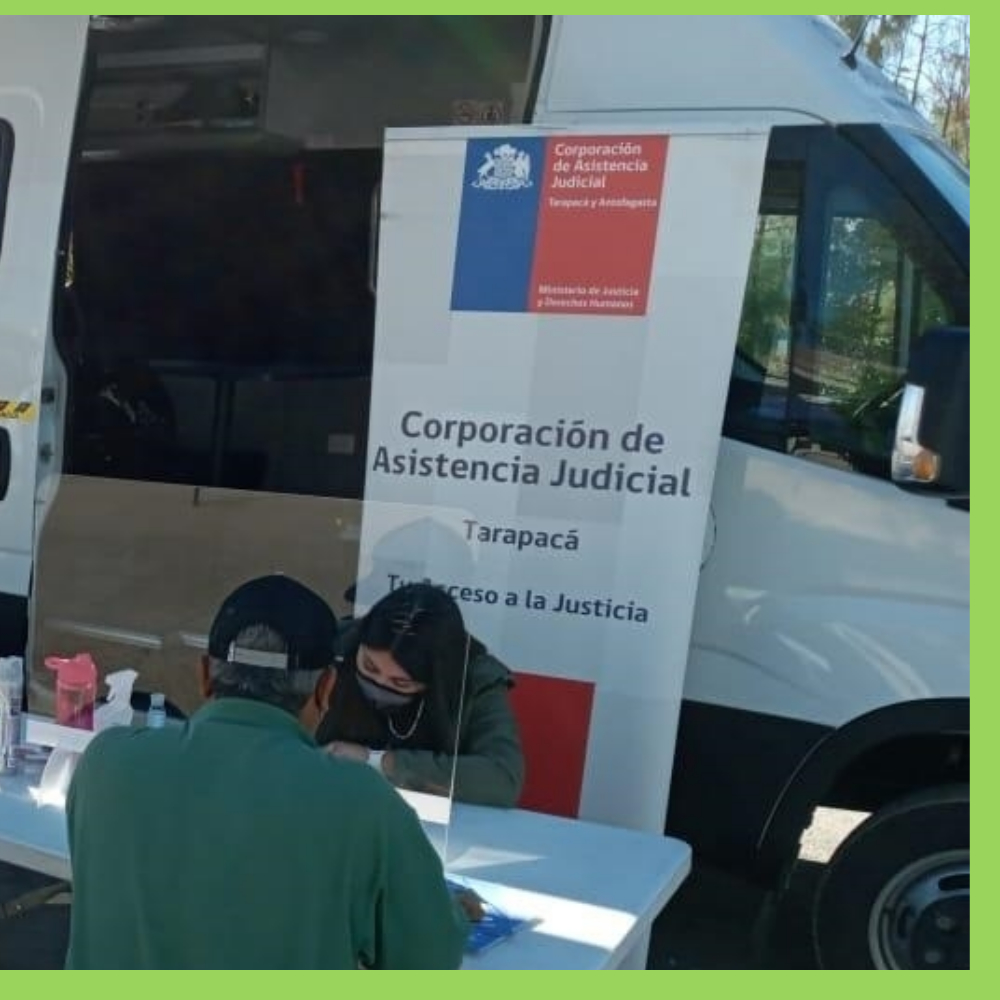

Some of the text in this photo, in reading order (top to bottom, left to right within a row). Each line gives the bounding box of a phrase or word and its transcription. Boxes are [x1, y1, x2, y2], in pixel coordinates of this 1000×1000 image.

[555, 142, 642, 158] Corporación
[552, 159, 648, 172] de Asistencia
[551, 175, 606, 188] Judicial
[590, 199, 597, 208] y
[400, 409, 665, 454] Corporación de
[372, 446, 692, 498] Asistencia Judicial
[463, 519, 580, 551] Tarapacá
[422, 577, 499, 605] ceso
[505, 591, 519, 607] a
[525, 589, 547, 610] la
[552, 593, 649, 623] Justicia
